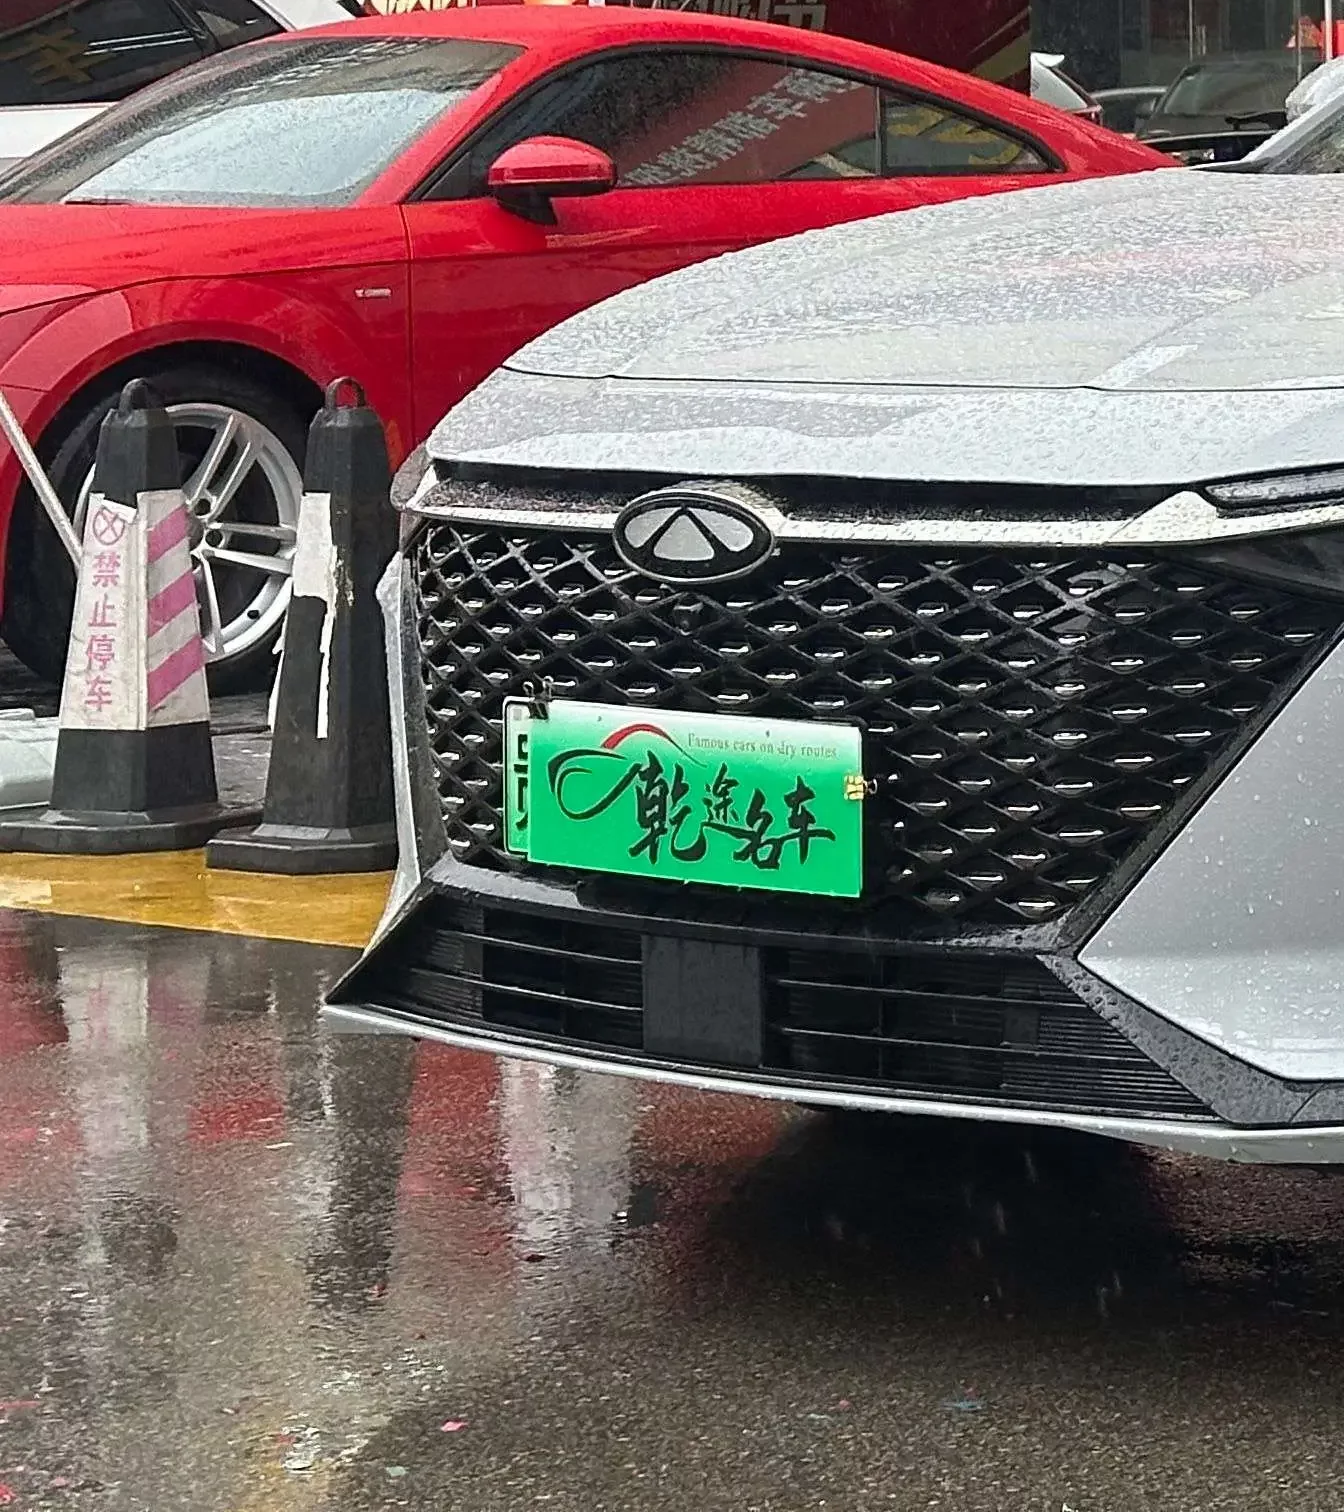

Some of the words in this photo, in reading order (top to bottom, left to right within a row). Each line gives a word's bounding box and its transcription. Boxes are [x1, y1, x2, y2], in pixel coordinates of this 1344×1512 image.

[84, 550, 122, 713] 禁止停车
[688, 732, 729, 749] Famous
[733, 740, 757, 753] cars
[759, 742, 775, 754] on
[776, 741, 797, 759] dry
[800, 744, 837, 759] routes
[626, 750, 836, 870] 乾途名车
